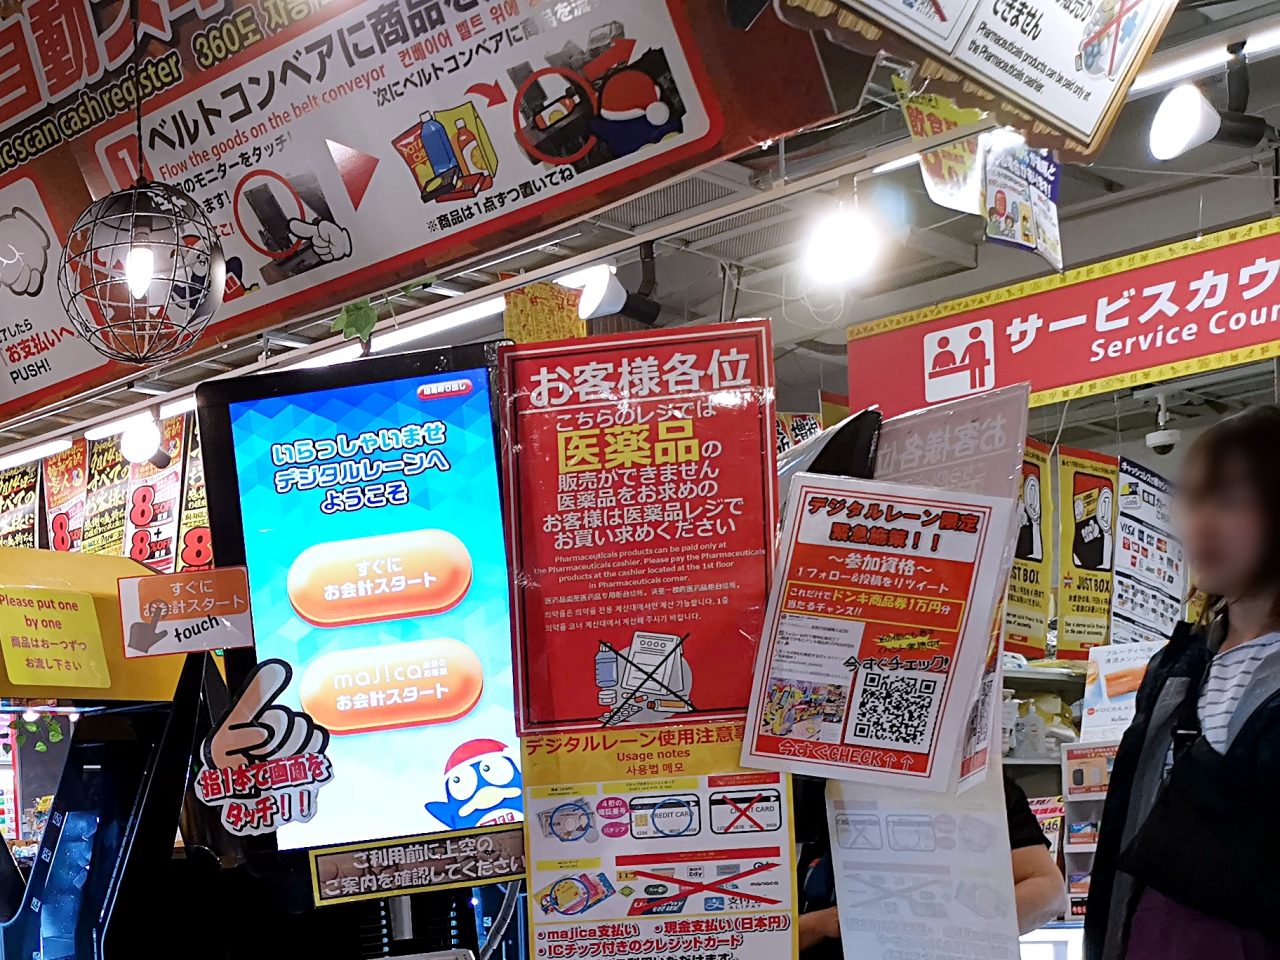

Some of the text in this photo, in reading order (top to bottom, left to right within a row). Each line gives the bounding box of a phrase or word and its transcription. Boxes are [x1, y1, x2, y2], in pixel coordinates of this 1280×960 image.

[1020, 49, 1048, 75] products
[1044, 63, 1057, 77] can
[1055, 69, 1065, 83] be
[1061, 71, 1077, 93] paid
[1073, 79, 1088, 98] only
[17, 121, 61, 162] scan
[60, 98, 103, 141] cash
[102, 54, 183, 116] register
[159, 63, 387, 183] Flow the goods on the belt conveyor
[1089, 313, 1208, 363] Service
[9, 360, 54, 386] PUSH!
[529, 347, 753, 408] お客様各位
[556, 401, 717, 432] こちらのレジでは
[271, 420, 447, 467] いらっしゃいませ
[558, 419, 723, 474] 医薬品の
[273, 450, 451, 493] デジタルレーンへ
[558, 461, 721, 492] 販売ができません
[320, 481, 410, 514] ようこそ
[557, 480, 719, 512] 医薬品をお求めの
[542, 496, 745, 534] お客様は医薬品レジで
[807, 495, 981, 535] デジタルレーン限定
[1120, 522, 1136, 537] VISA
[554, 520, 737, 551] お買い求めください
[618, 548, 654, 559] products
[654, 547, 668, 555] can
[669, 545, 680, 553] be
[681, 543, 699, 554] paid
[699, 542, 717, 552] only
[718, 541, 727, 549] at
[355, 556, 404, 575] すぐに
[548, 561, 611, 573] Pharmaceuticals
[612, 558, 643, 568] cashier.
[644, 555, 670, 565] Please
[670, 554, 686, 564] pay
[686, 553, 700, 561] the
[700, 547, 766, 559] Pharmaceuticals
[558, 560, 735, 584] products at the cashier located at the 1st floor
[170, 578, 214, 595] すぐに
[322, 571, 438, 601] お会計スタート
[588, 574, 691, 590] in Pharmaceuticals corner.
[36, 598, 56, 613] put
[56, 601, 79, 612] one
[24, 615, 63, 631] by one
[173, 613, 221, 643] touch
[10, 635, 88, 652] 商品はお一つずつ
[24, 657, 83, 672] お流し下さい
[333, 665, 422, 691] majica
[335, 683, 450, 712] お会計スタート
[616, 749, 691, 764] Usage notes
[625, 762, 686, 777] 사용법 메모
[754, 804, 776, 814] CARD
[351, 836, 495, 870] ご利用前に上空の
[324, 854, 527, 895] ご案内を確認してください
